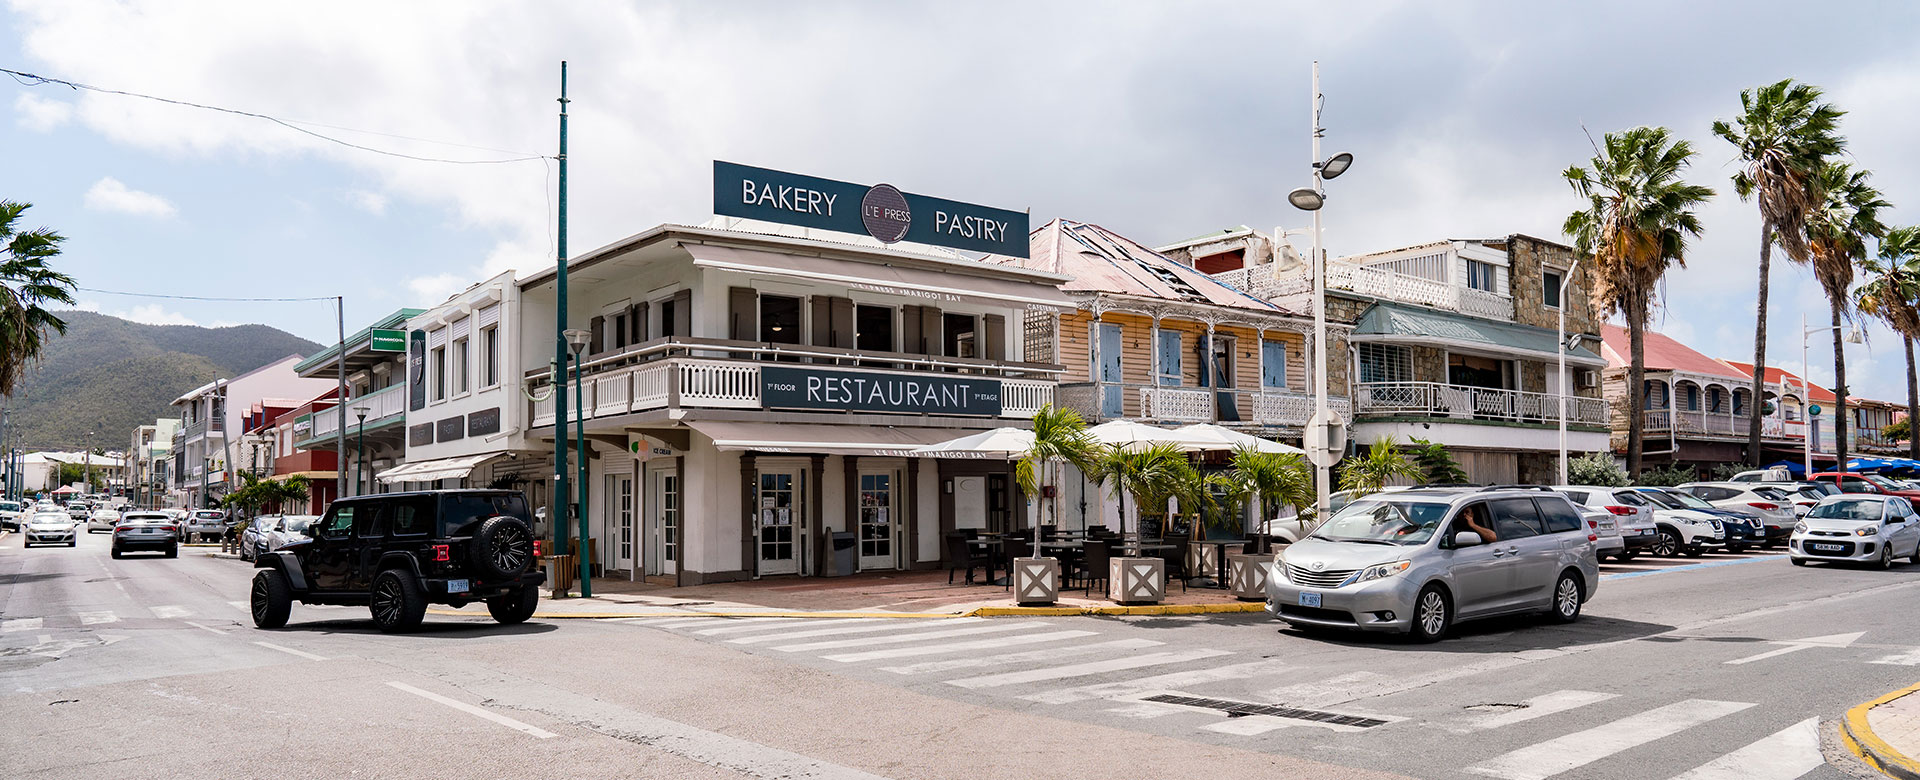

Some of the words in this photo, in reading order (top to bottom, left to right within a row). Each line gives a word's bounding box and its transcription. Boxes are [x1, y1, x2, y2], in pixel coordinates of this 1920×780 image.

[742, 179, 838, 217] BAKERY
[864, 204, 912, 223] L'EXPRESS
[934, 210, 1008, 243] PASTRY
[774, 384, 796, 392] FLOOR
[807, 376, 970, 408] RESTAURANT
